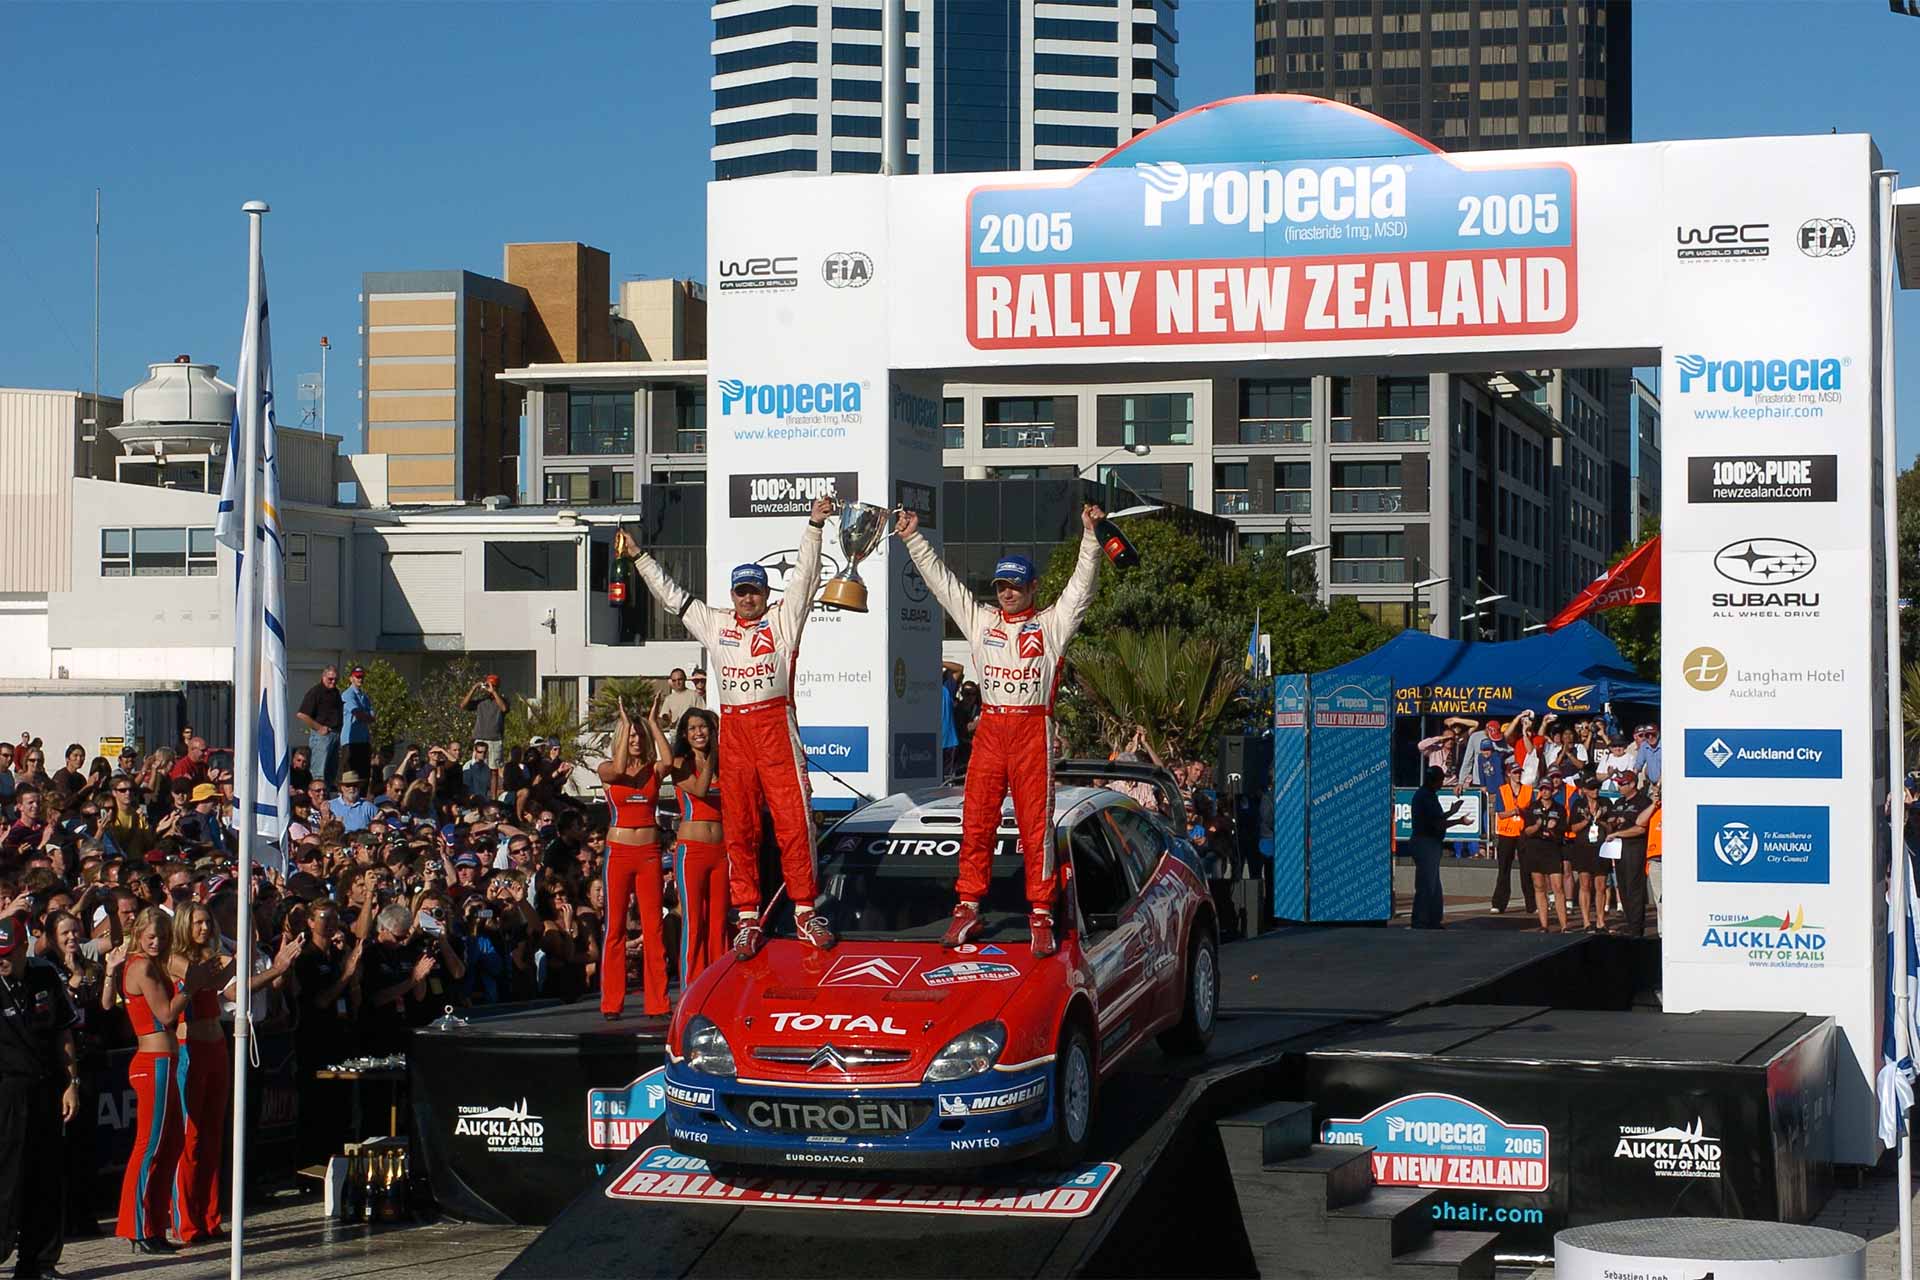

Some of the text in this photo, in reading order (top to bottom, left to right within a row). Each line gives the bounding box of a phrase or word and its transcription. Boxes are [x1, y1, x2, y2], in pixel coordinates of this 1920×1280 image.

[1136, 161, 1407, 232] Propecia
[1457, 193, 1560, 237] 2005
[979, 211, 1073, 254] 2005
[1285, 225, 1342, 243] (finasteride
[1374, 221, 1408, 239] MSD)
[1677, 223, 1769, 244] WRC
[719, 256, 798, 277] WRC
[976, 256, 1568, 339] RALLY NEW ZEALAND
[1673, 353, 1842, 397] Propecia
[717, 378, 862, 419] Propecia
[1694, 405, 1823, 420] www.keephair.com
[734, 425, 846, 440] www.keephair.com
[1712, 485, 1812, 499] newzealand.com
[1712, 593, 1820, 607] SUBARU
[722, 676, 775, 692] SPORT
[839, 671, 871, 682] Hotel
[1737, 669, 1845, 685] Langham Hotel
[984, 679, 1041, 694] SPORT
[1434, 686, 1475, 699] RALLY
[1476, 686, 1513, 699] TEAM
[1729, 688, 1776, 698] Auckland
[1317, 713, 1337, 725] RALLY
[1337, 713, 1354, 725] NEW
[1355, 713, 1385, 726] ZEALAND
[828, 744, 851, 757] City
[1736, 747, 1822, 762] Auckland City
[1312, 760, 1388, 806] www.keephair.com
[868, 839, 1004, 856] CITRO
[1764, 842, 1812, 852] MANUKAU
[1783, 855, 1809, 863] Council
[1709, 914, 1749, 922] TOURISM
[1702, 927, 1826, 950] AUCKLAND
[1748, 950, 1825, 961] CITY OF SAILS
[769, 1012, 907, 1035] TOTAL
[667, 1085, 711, 1105] CHELIN
[971, 1081, 1046, 1110] MICHELIN
[594, 1100, 626, 1115] 2005
[748, 1099, 908, 1130] CITROËN
[454, 1118, 544, 1137] AUCKLAND
[674, 1128, 708, 1143] NAVTEQ
[1385, 1116, 1487, 1146] Propecia
[1619, 1126, 1656, 1134] TOURISM
[487, 1137, 544, 1146] CITY OF SAILS
[951, 1137, 1000, 1150] NAVTEQ
[1504, 1137, 1542, 1154] 2005
[1613, 1139, 1722, 1161] AUCKLAND
[646, 1155, 709, 1172] 200
[785, 1153, 865, 1164] EURODATACAR
[1654, 1160, 1721, 1171] CITY OF SAILS
[1393, 1156, 1444, 1182] NEW
[1447, 1158, 1544, 1187] ZEALAND
